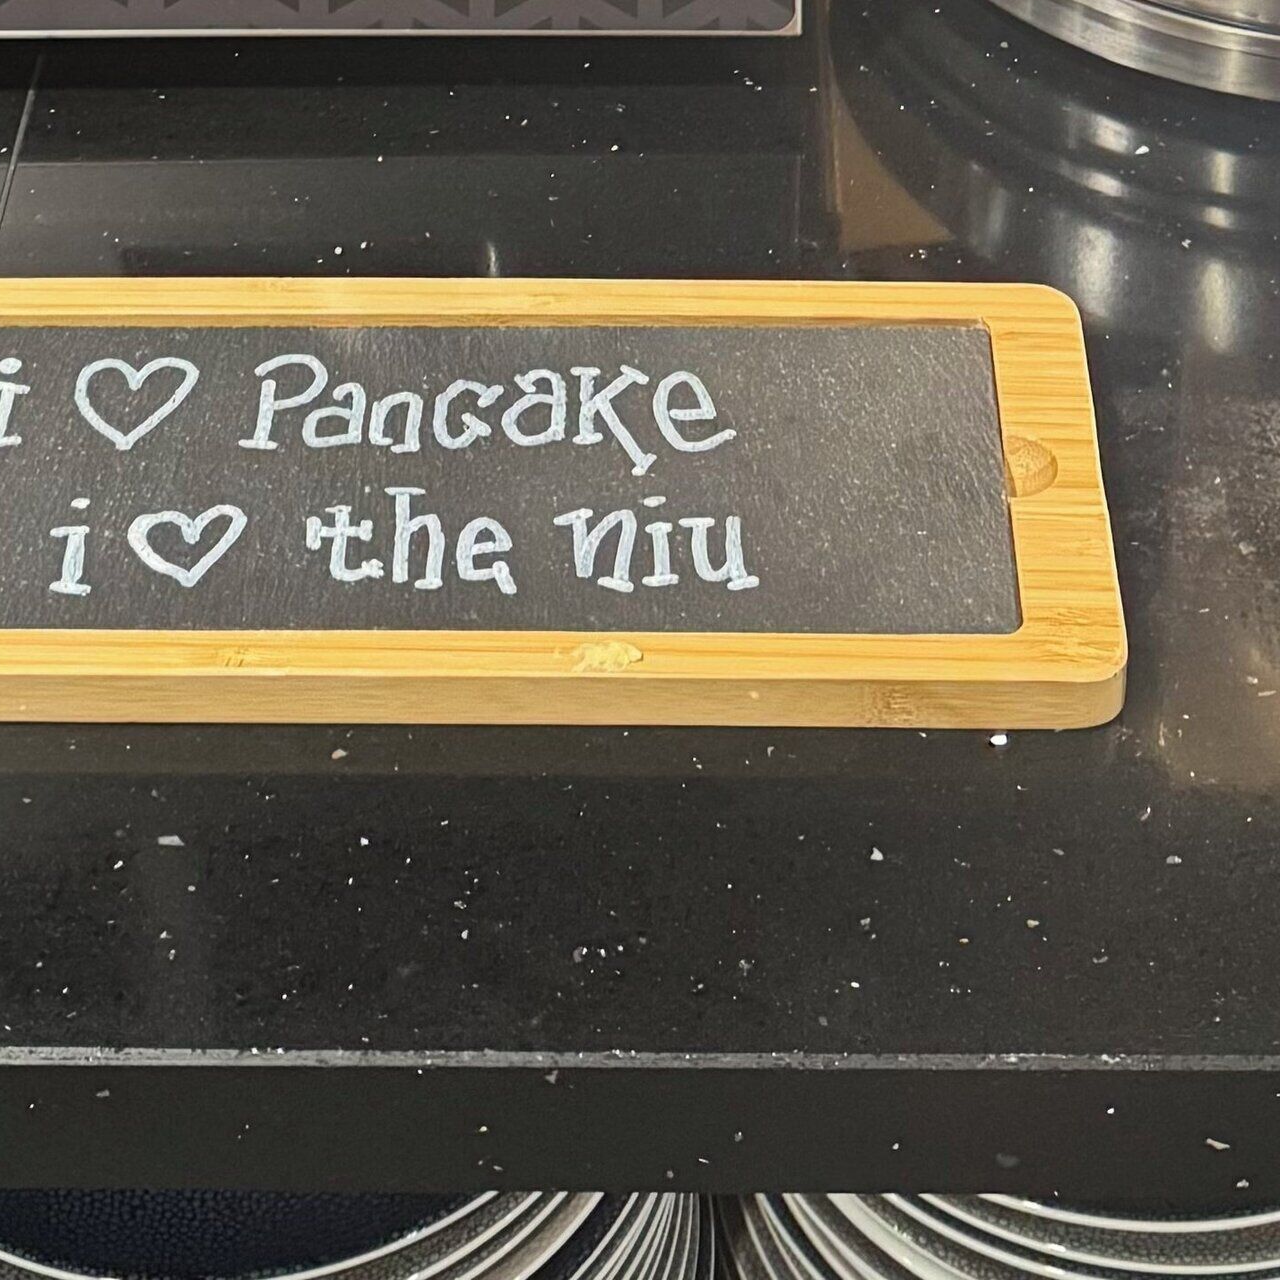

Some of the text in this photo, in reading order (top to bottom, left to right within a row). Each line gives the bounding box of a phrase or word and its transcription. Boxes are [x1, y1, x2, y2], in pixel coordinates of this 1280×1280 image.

[49, 486, 761, 595] i the niu
